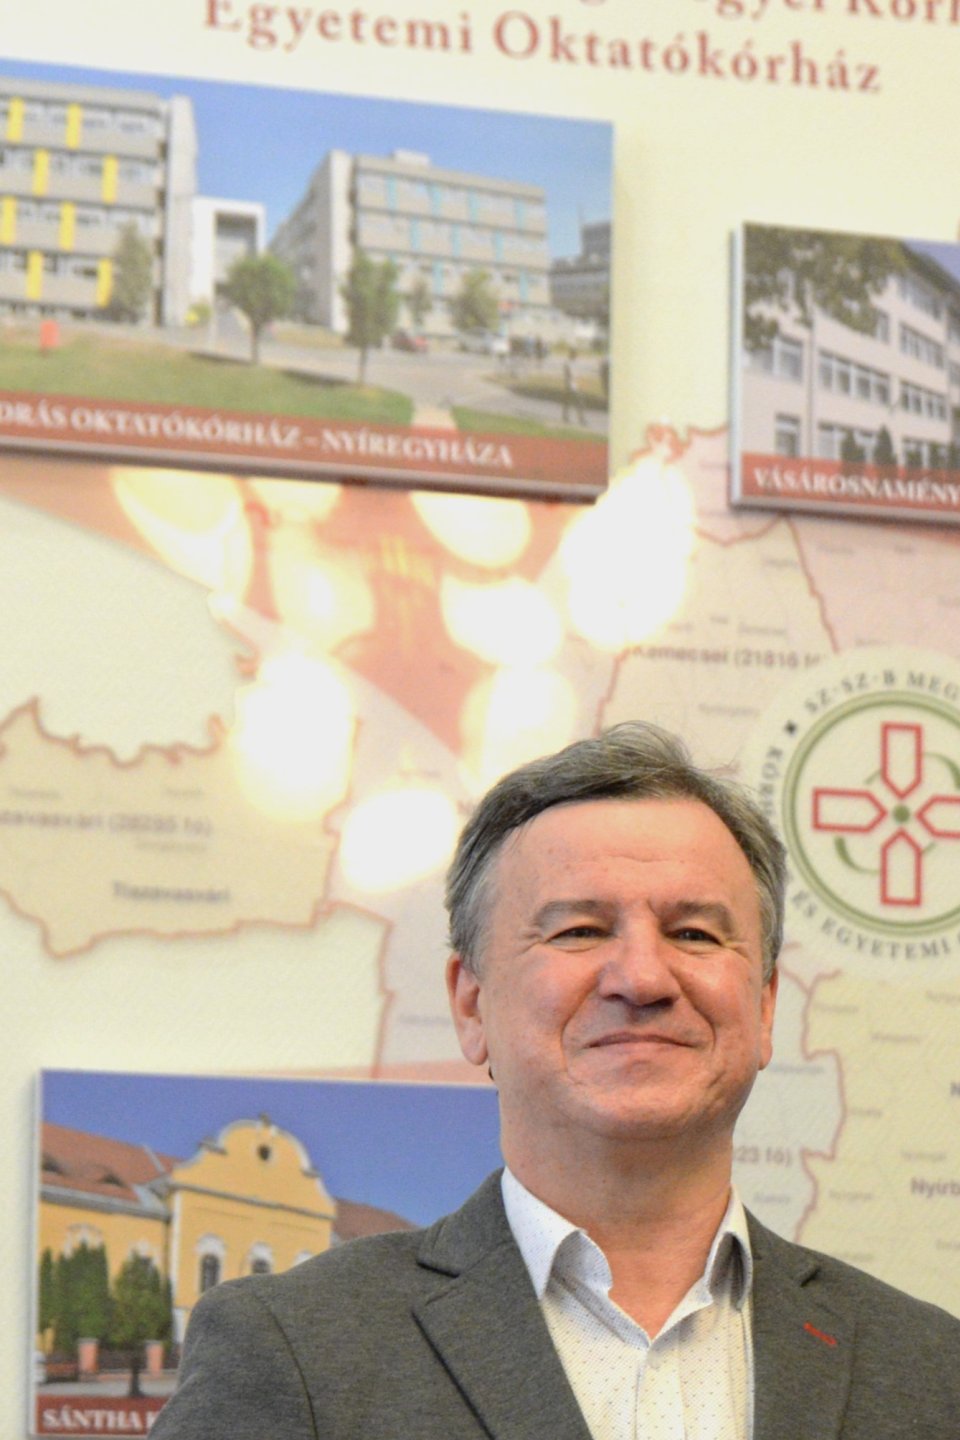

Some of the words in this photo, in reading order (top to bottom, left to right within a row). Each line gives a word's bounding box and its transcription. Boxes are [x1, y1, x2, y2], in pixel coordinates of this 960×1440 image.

[204, 0, 473, 53] Egyetemi
[492, 9, 882, 93] Oktatókórház
[70, 406, 301, 448] OKTATÓKÓRHÁZ
[321, 425, 514, 468] NYÍREGYHÁZA
[820, 916, 952, 961] EGYETEMI
[43, 1404, 143, 1431] SÁNTHA
